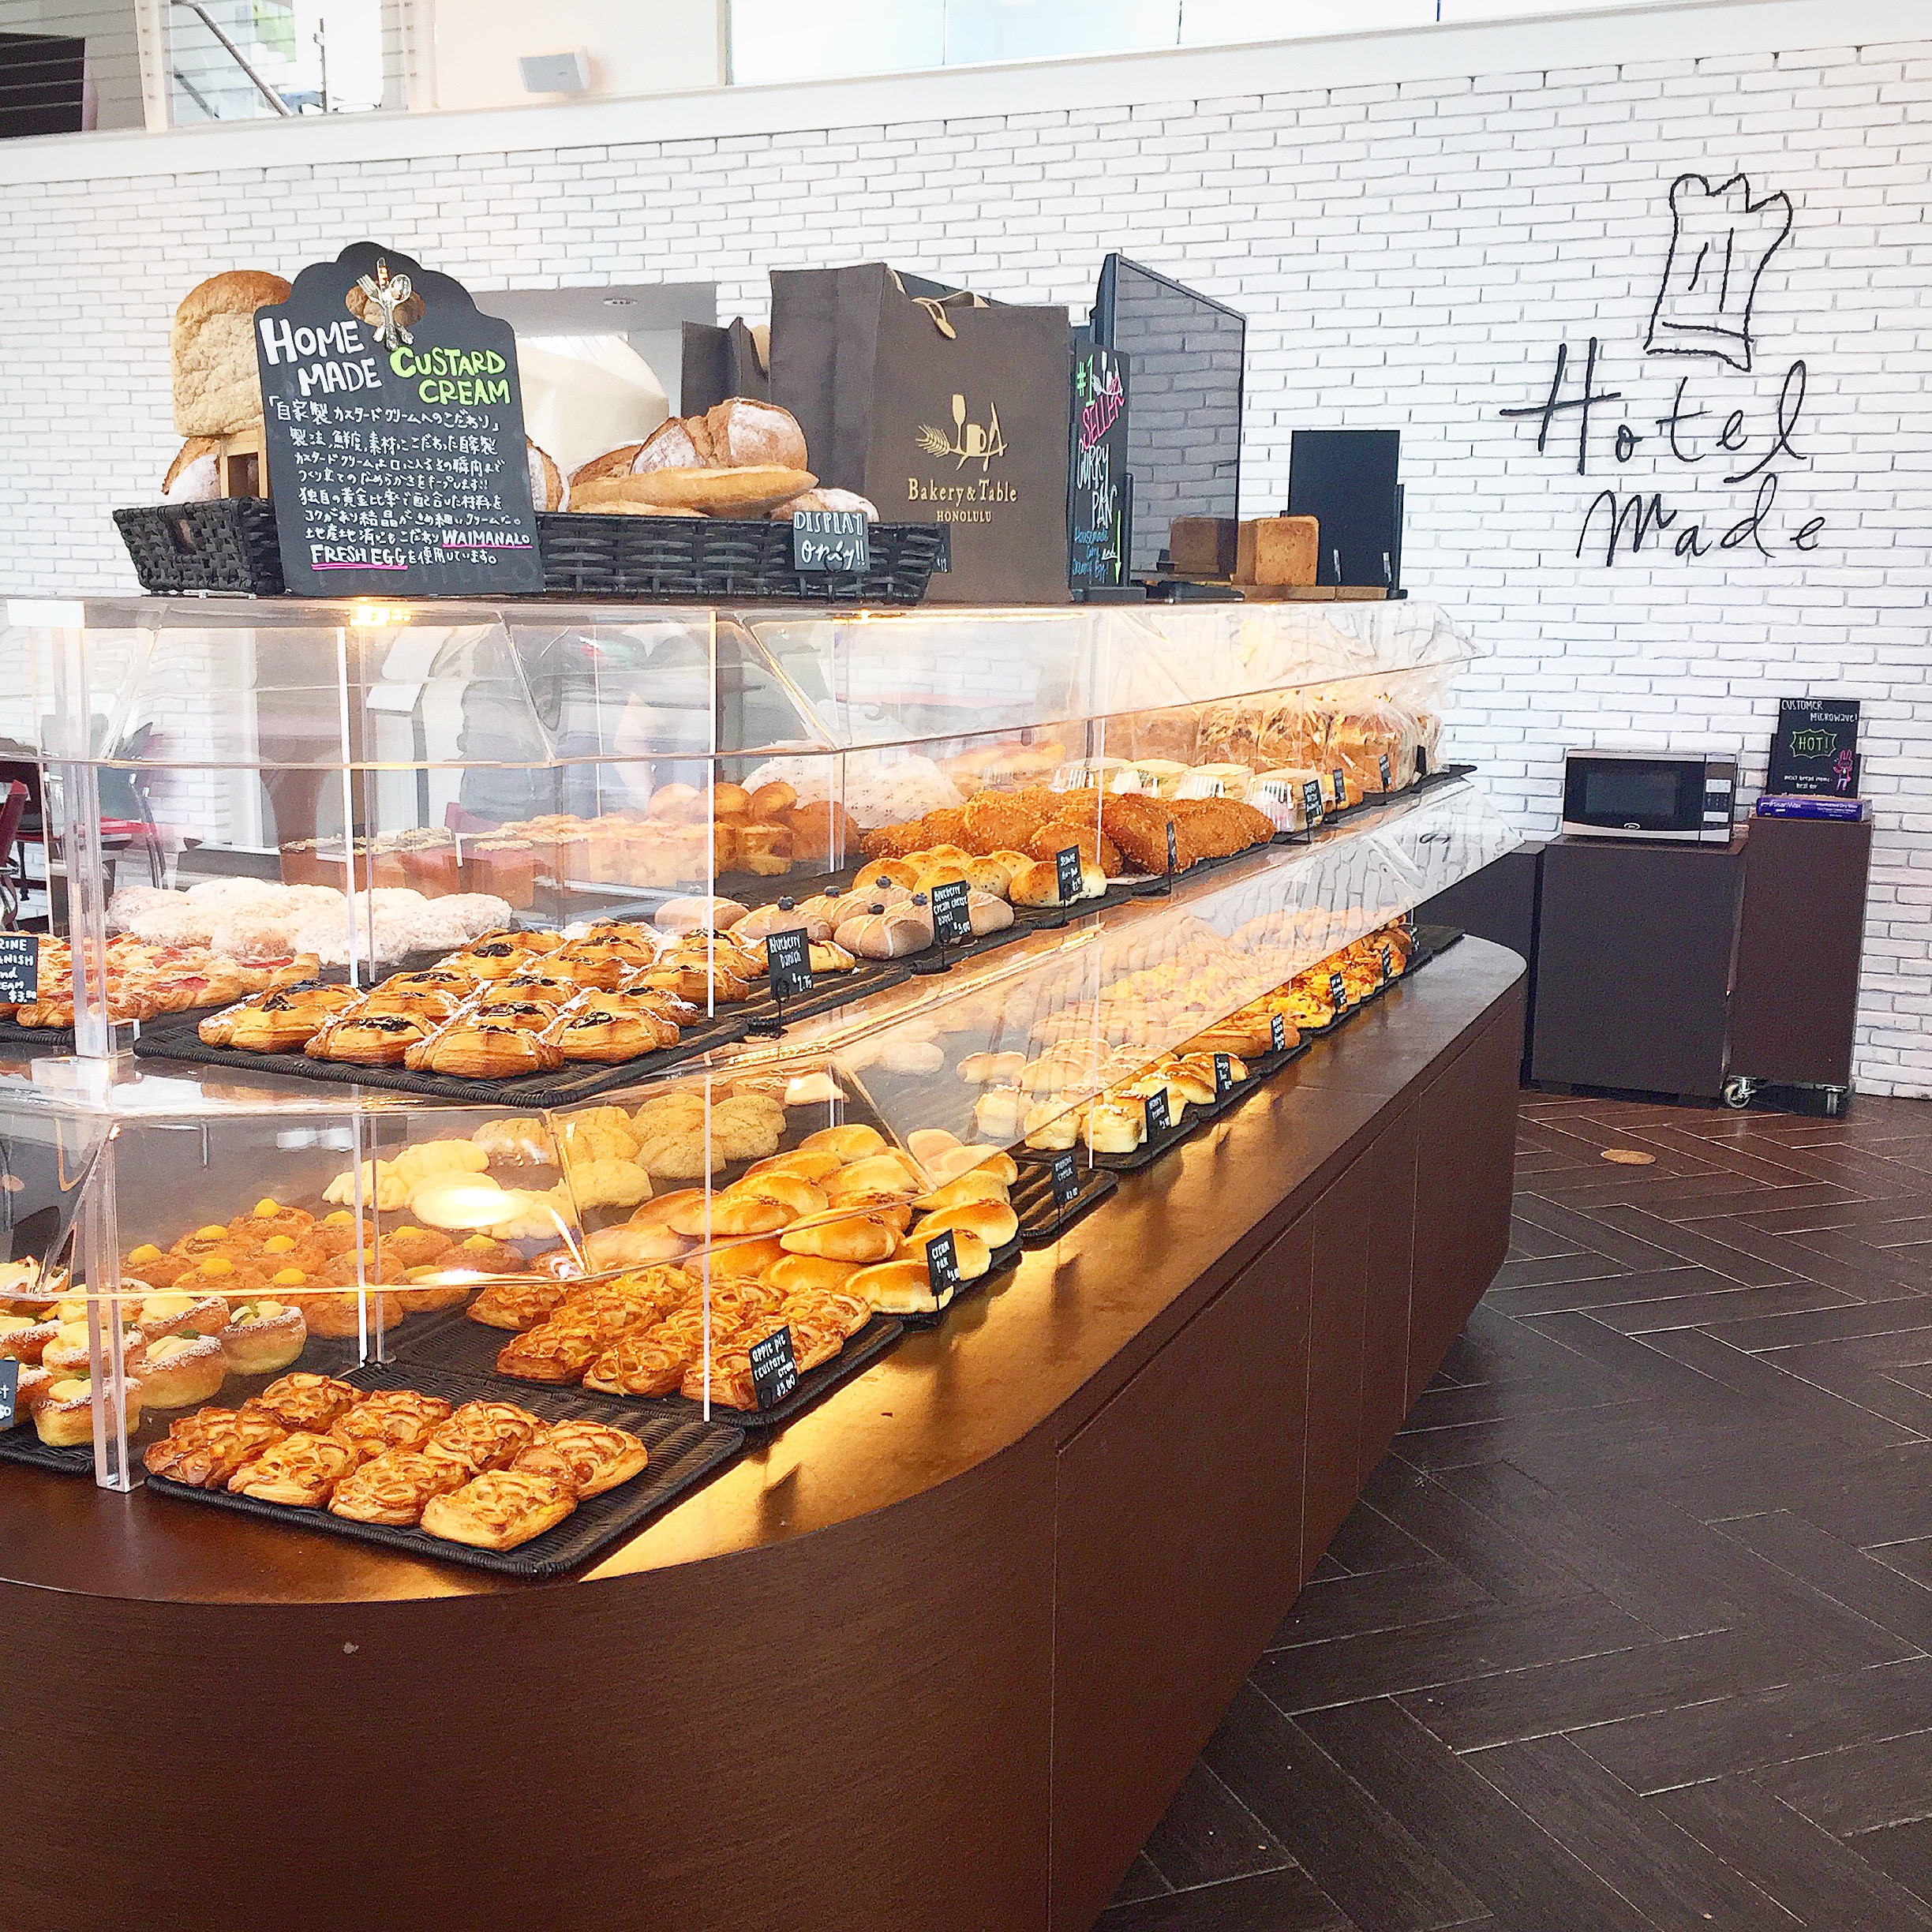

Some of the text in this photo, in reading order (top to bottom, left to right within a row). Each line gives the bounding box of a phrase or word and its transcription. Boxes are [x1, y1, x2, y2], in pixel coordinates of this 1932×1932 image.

[259, 317, 365, 365] HOME
[389, 346, 507, 377] CUSTARD
[298, 358, 383, 396] MADE
[1076, 354, 1096, 408] #1
[418, 379, 511, 406] CREAM
[1499, 337, 1807, 483] Hotel
[908, 477, 1018, 507] Bakery & Table
[794, 512, 864, 536] DISPLAY
[936, 510, 993, 522] HONOLULU
[442, 529, 530, 546] WAIMANALO
[310, 544, 368, 564] FRESH
[1799, 737, 1829, 754] HOT!
